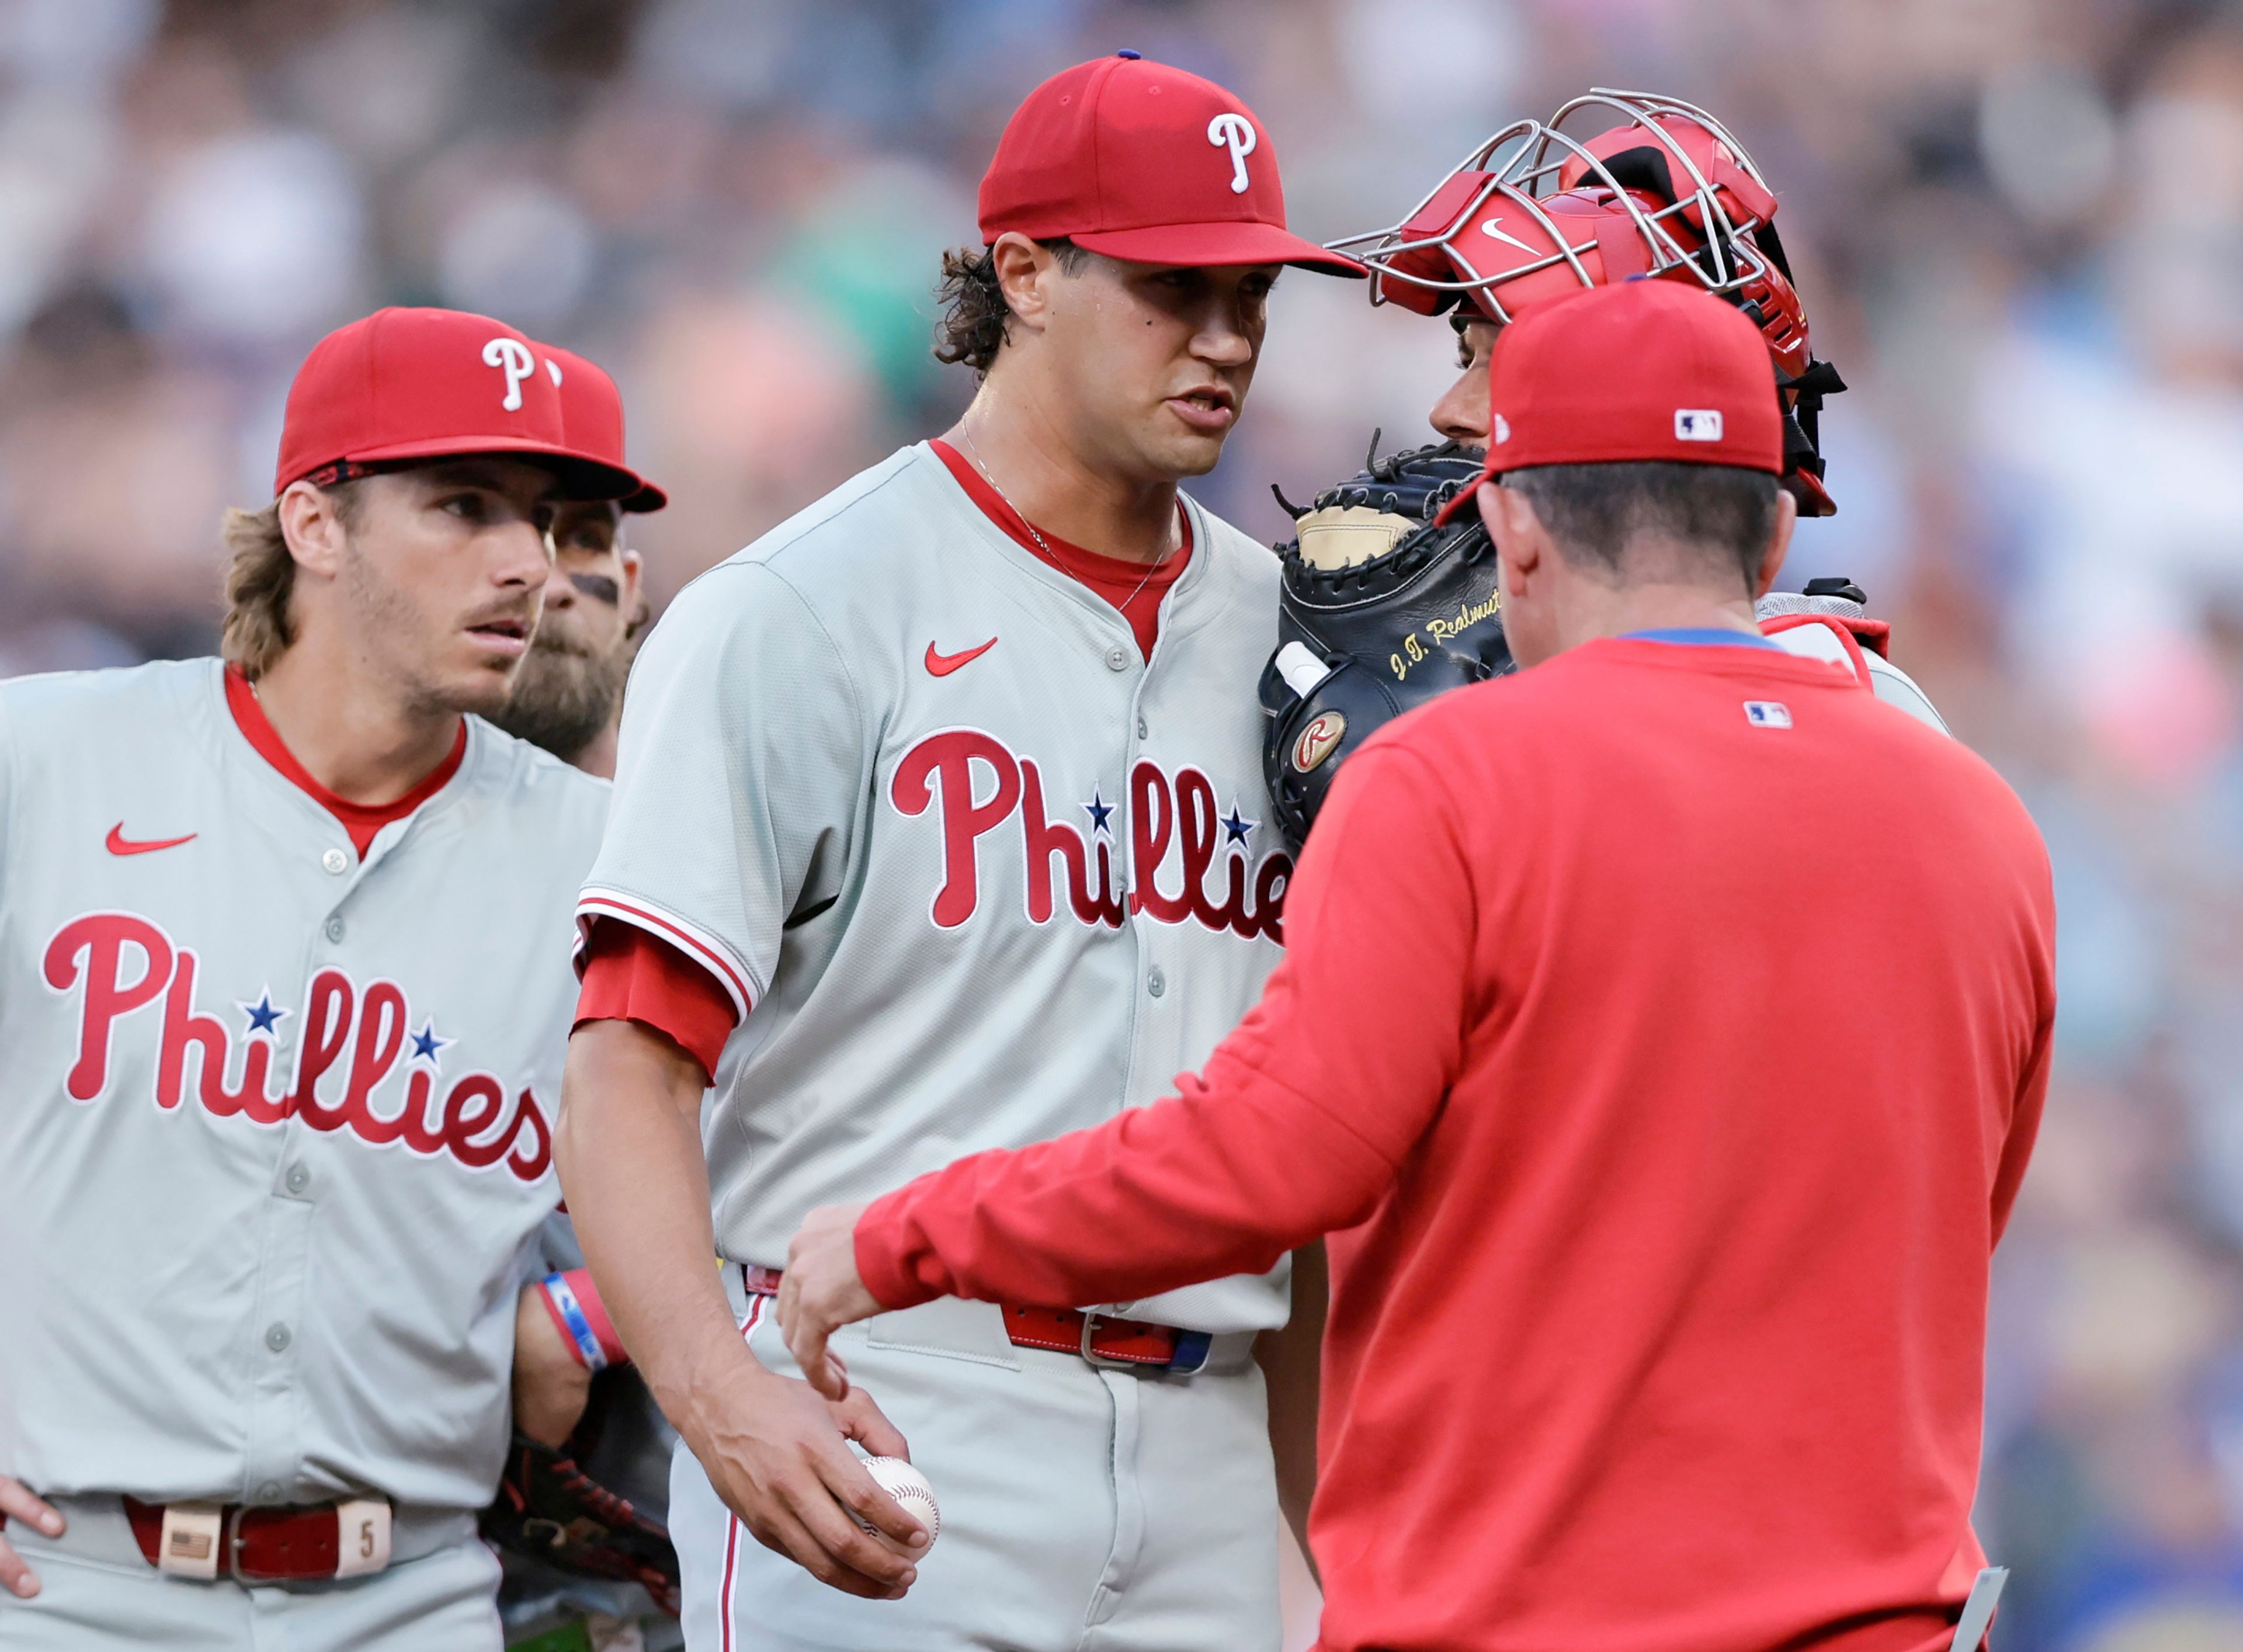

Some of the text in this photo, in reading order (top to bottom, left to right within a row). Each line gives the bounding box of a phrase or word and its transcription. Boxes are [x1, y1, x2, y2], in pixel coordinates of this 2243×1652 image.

[1207, 113, 1257, 194] P
[481, 337, 535, 412] P
[1390, 633, 1429, 681] J.T.
[1298, 718, 1337, 768] R
[40, 908, 553, 1186] Phillies
[359, 1520, 375, 1559] 5
